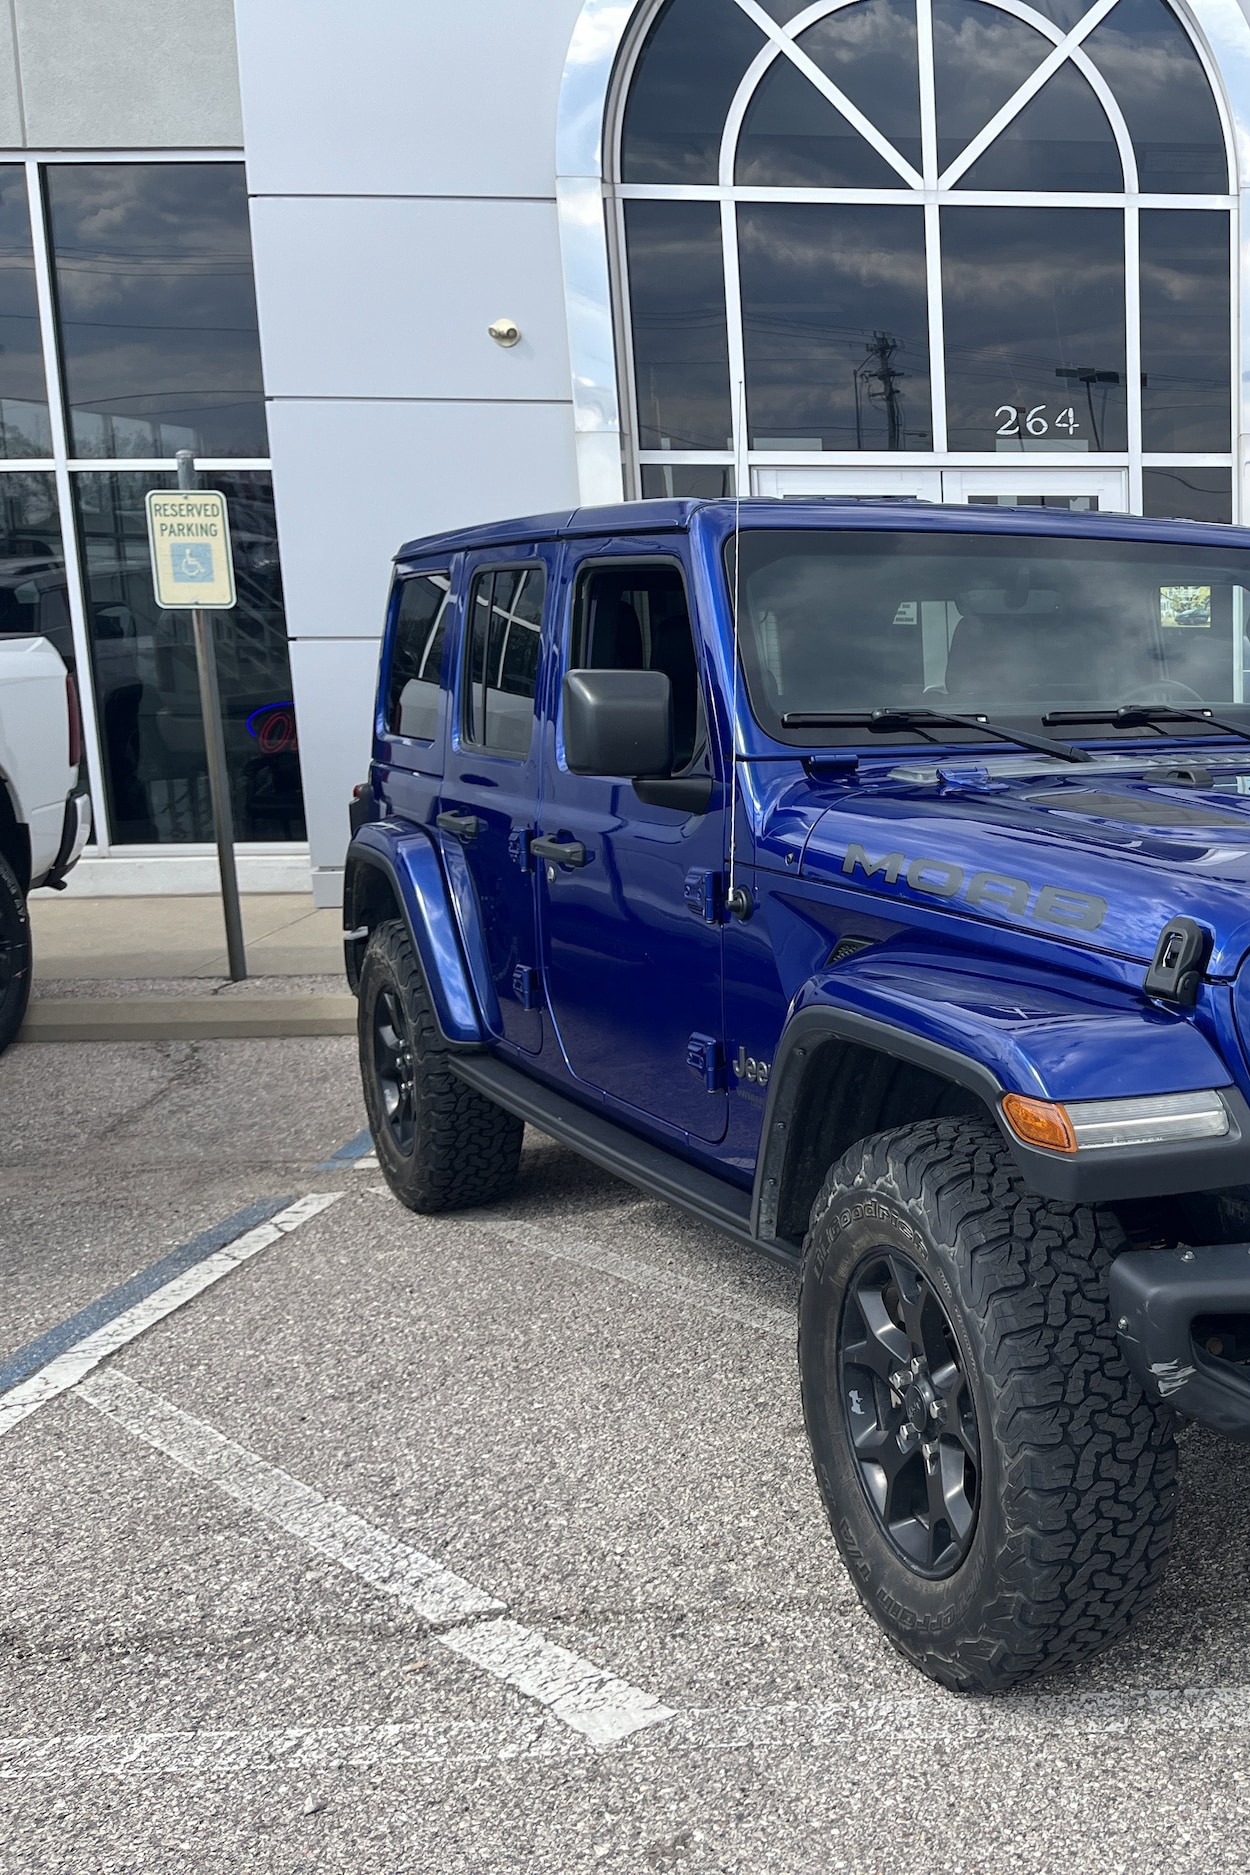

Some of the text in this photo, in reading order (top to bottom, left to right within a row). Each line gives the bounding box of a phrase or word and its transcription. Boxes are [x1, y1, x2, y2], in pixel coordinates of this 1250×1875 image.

[995, 404, 1080, 435] 264
[154, 503, 220, 518] RESERVED
[160, 523, 218, 537] PARKING
[841, 843, 1108, 932] MOAB
[732, 1046, 772, 1086] Jee
